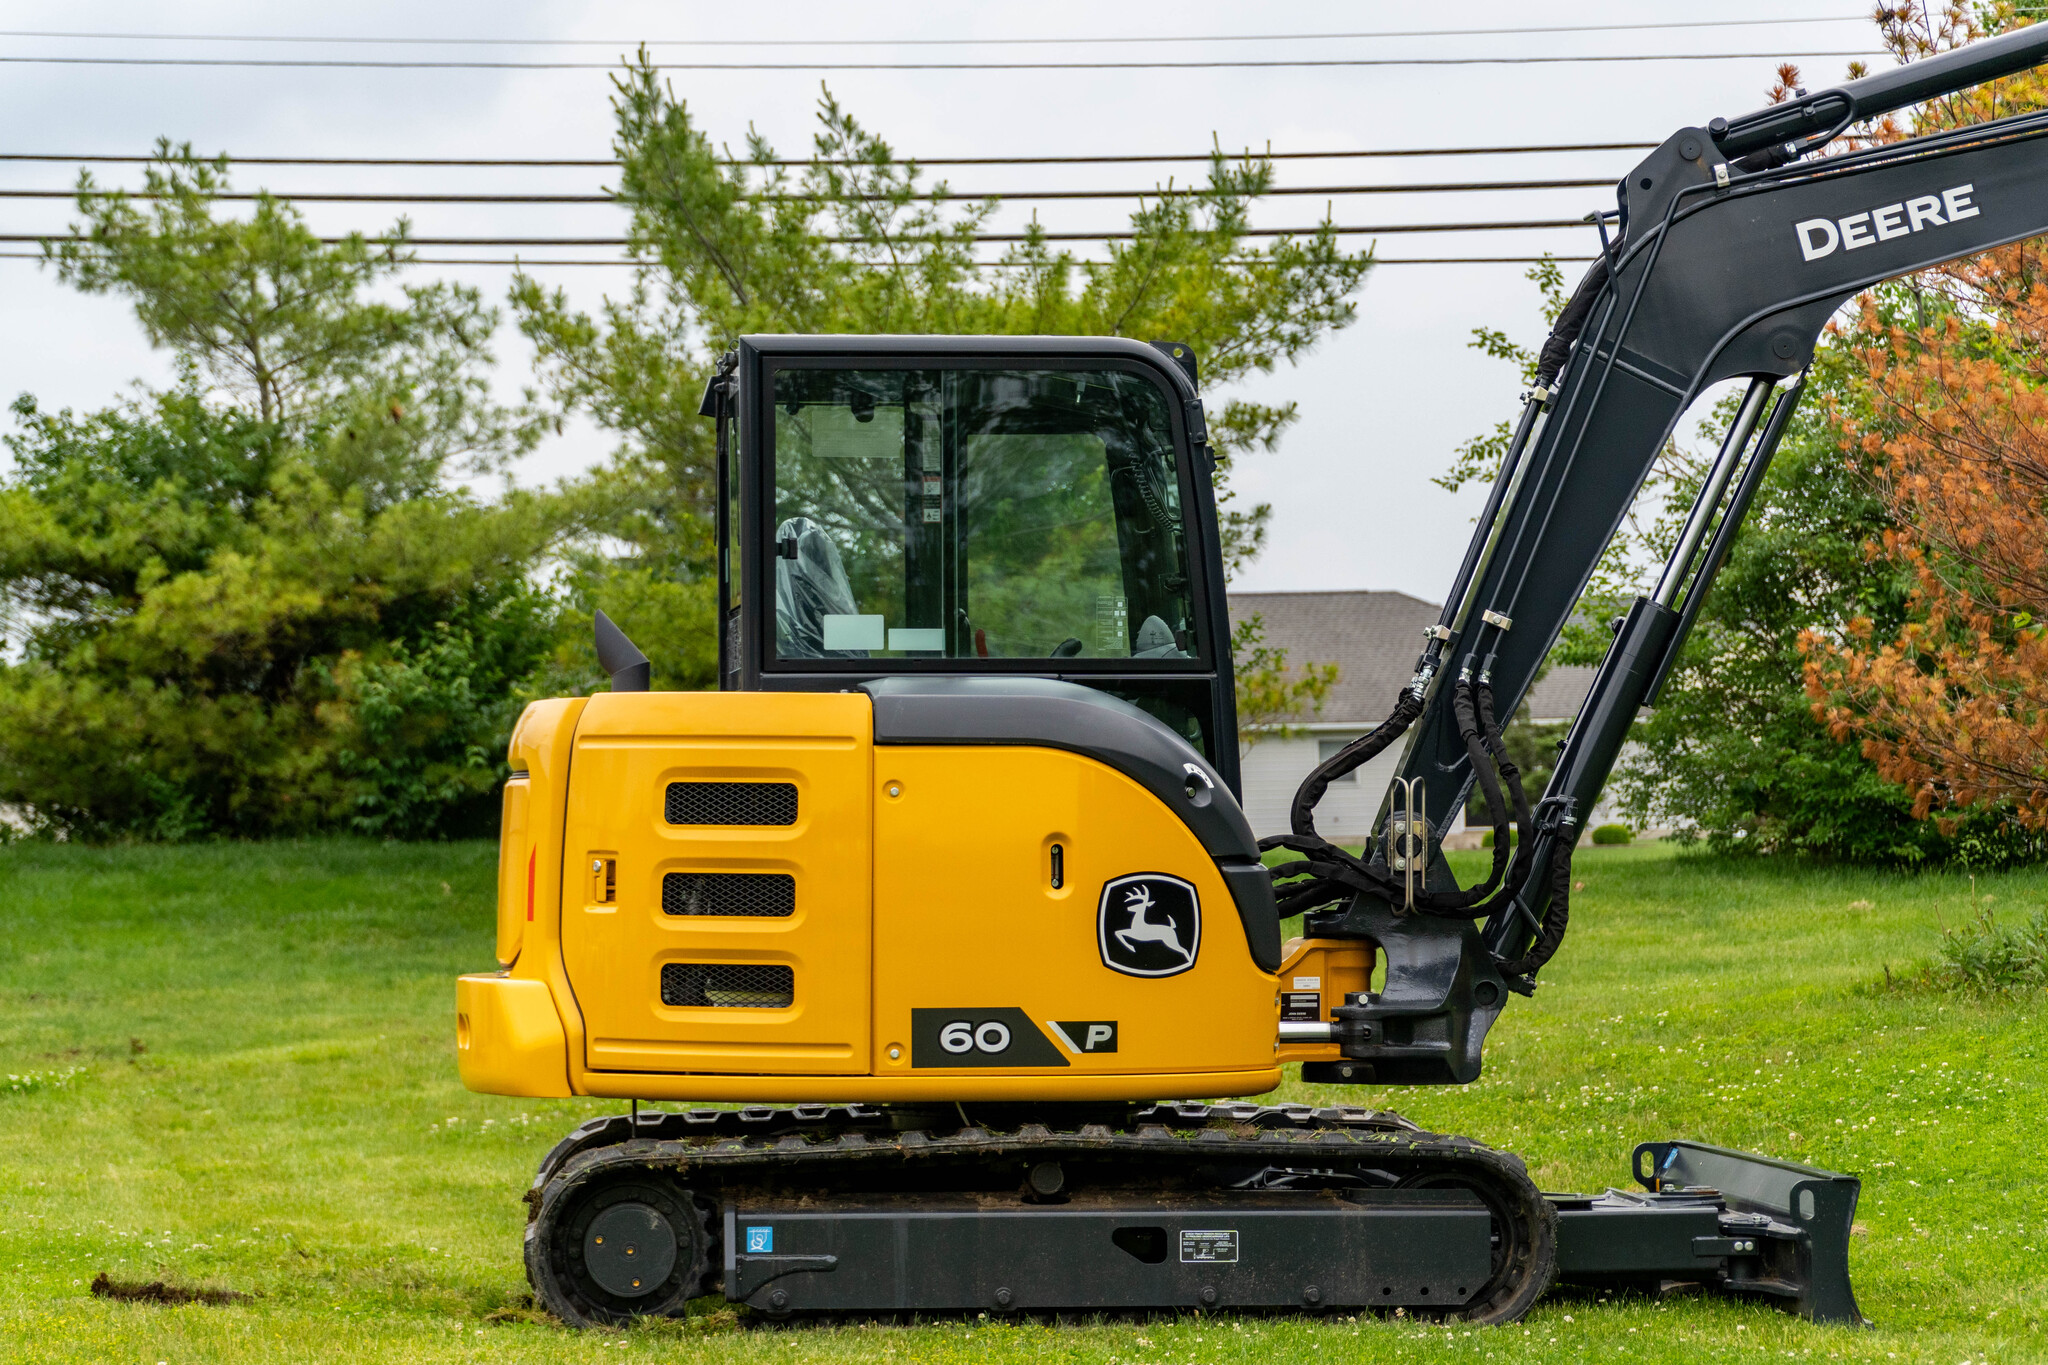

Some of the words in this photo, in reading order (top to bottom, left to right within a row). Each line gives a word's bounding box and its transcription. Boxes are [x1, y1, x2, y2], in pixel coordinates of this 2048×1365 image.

[1795, 184, 1980, 262] DEERE
[940, 1021, 1011, 1053] 60
[1085, 1024, 1113, 1050] P
